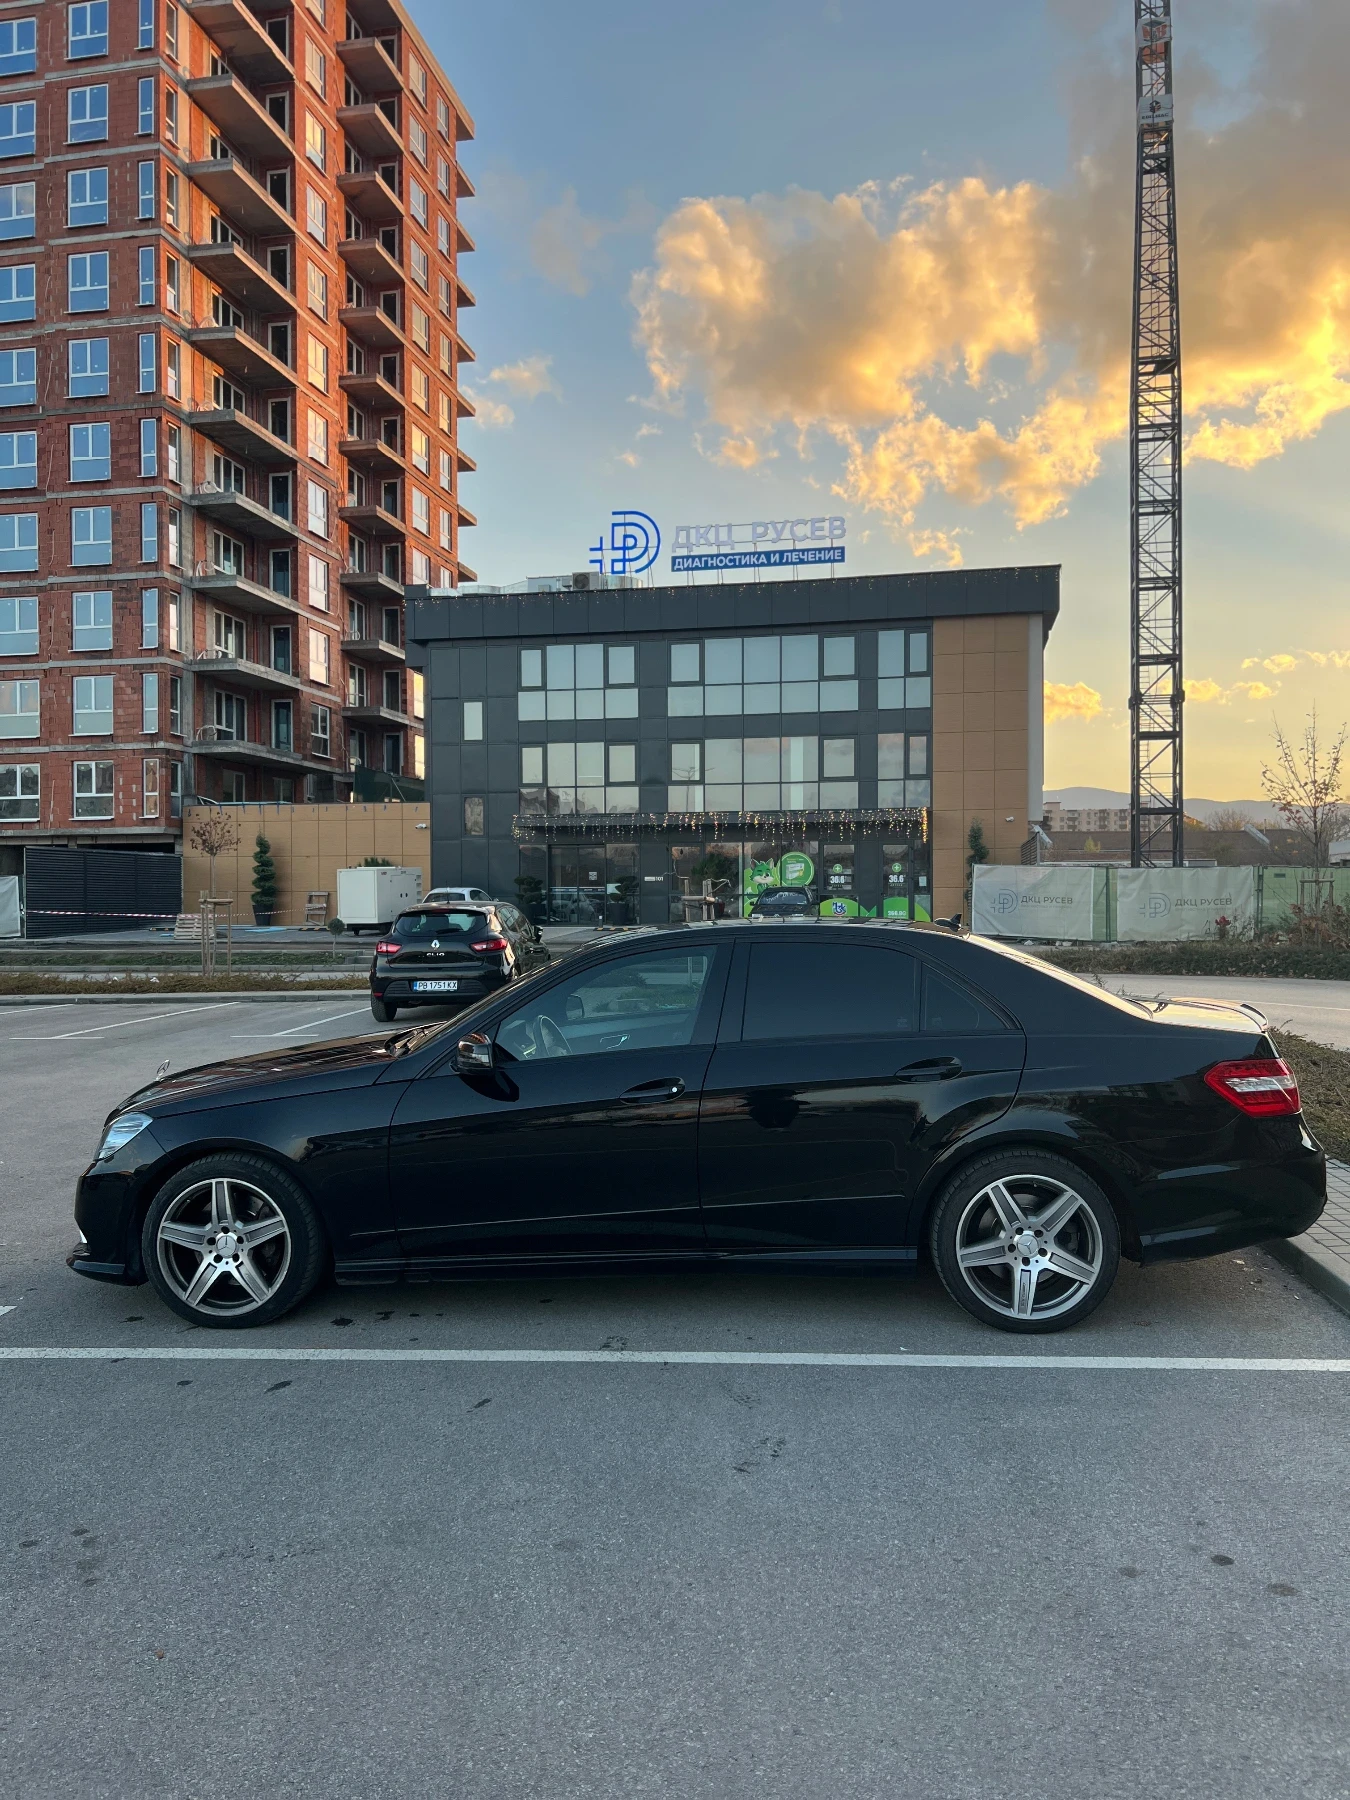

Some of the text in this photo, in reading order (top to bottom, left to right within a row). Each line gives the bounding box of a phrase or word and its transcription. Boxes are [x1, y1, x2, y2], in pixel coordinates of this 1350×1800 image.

[672, 516, 846, 553] ДКЦ РУСЕВ
[674, 549, 842, 570] ДИАГНОСТИКА И ЛЕЧЕНИЕ
[1020, 895, 1073, 904] ДКЦ РУСЕВ
[1174, 898, 1233, 907] ДКЦ РУСЕВ
